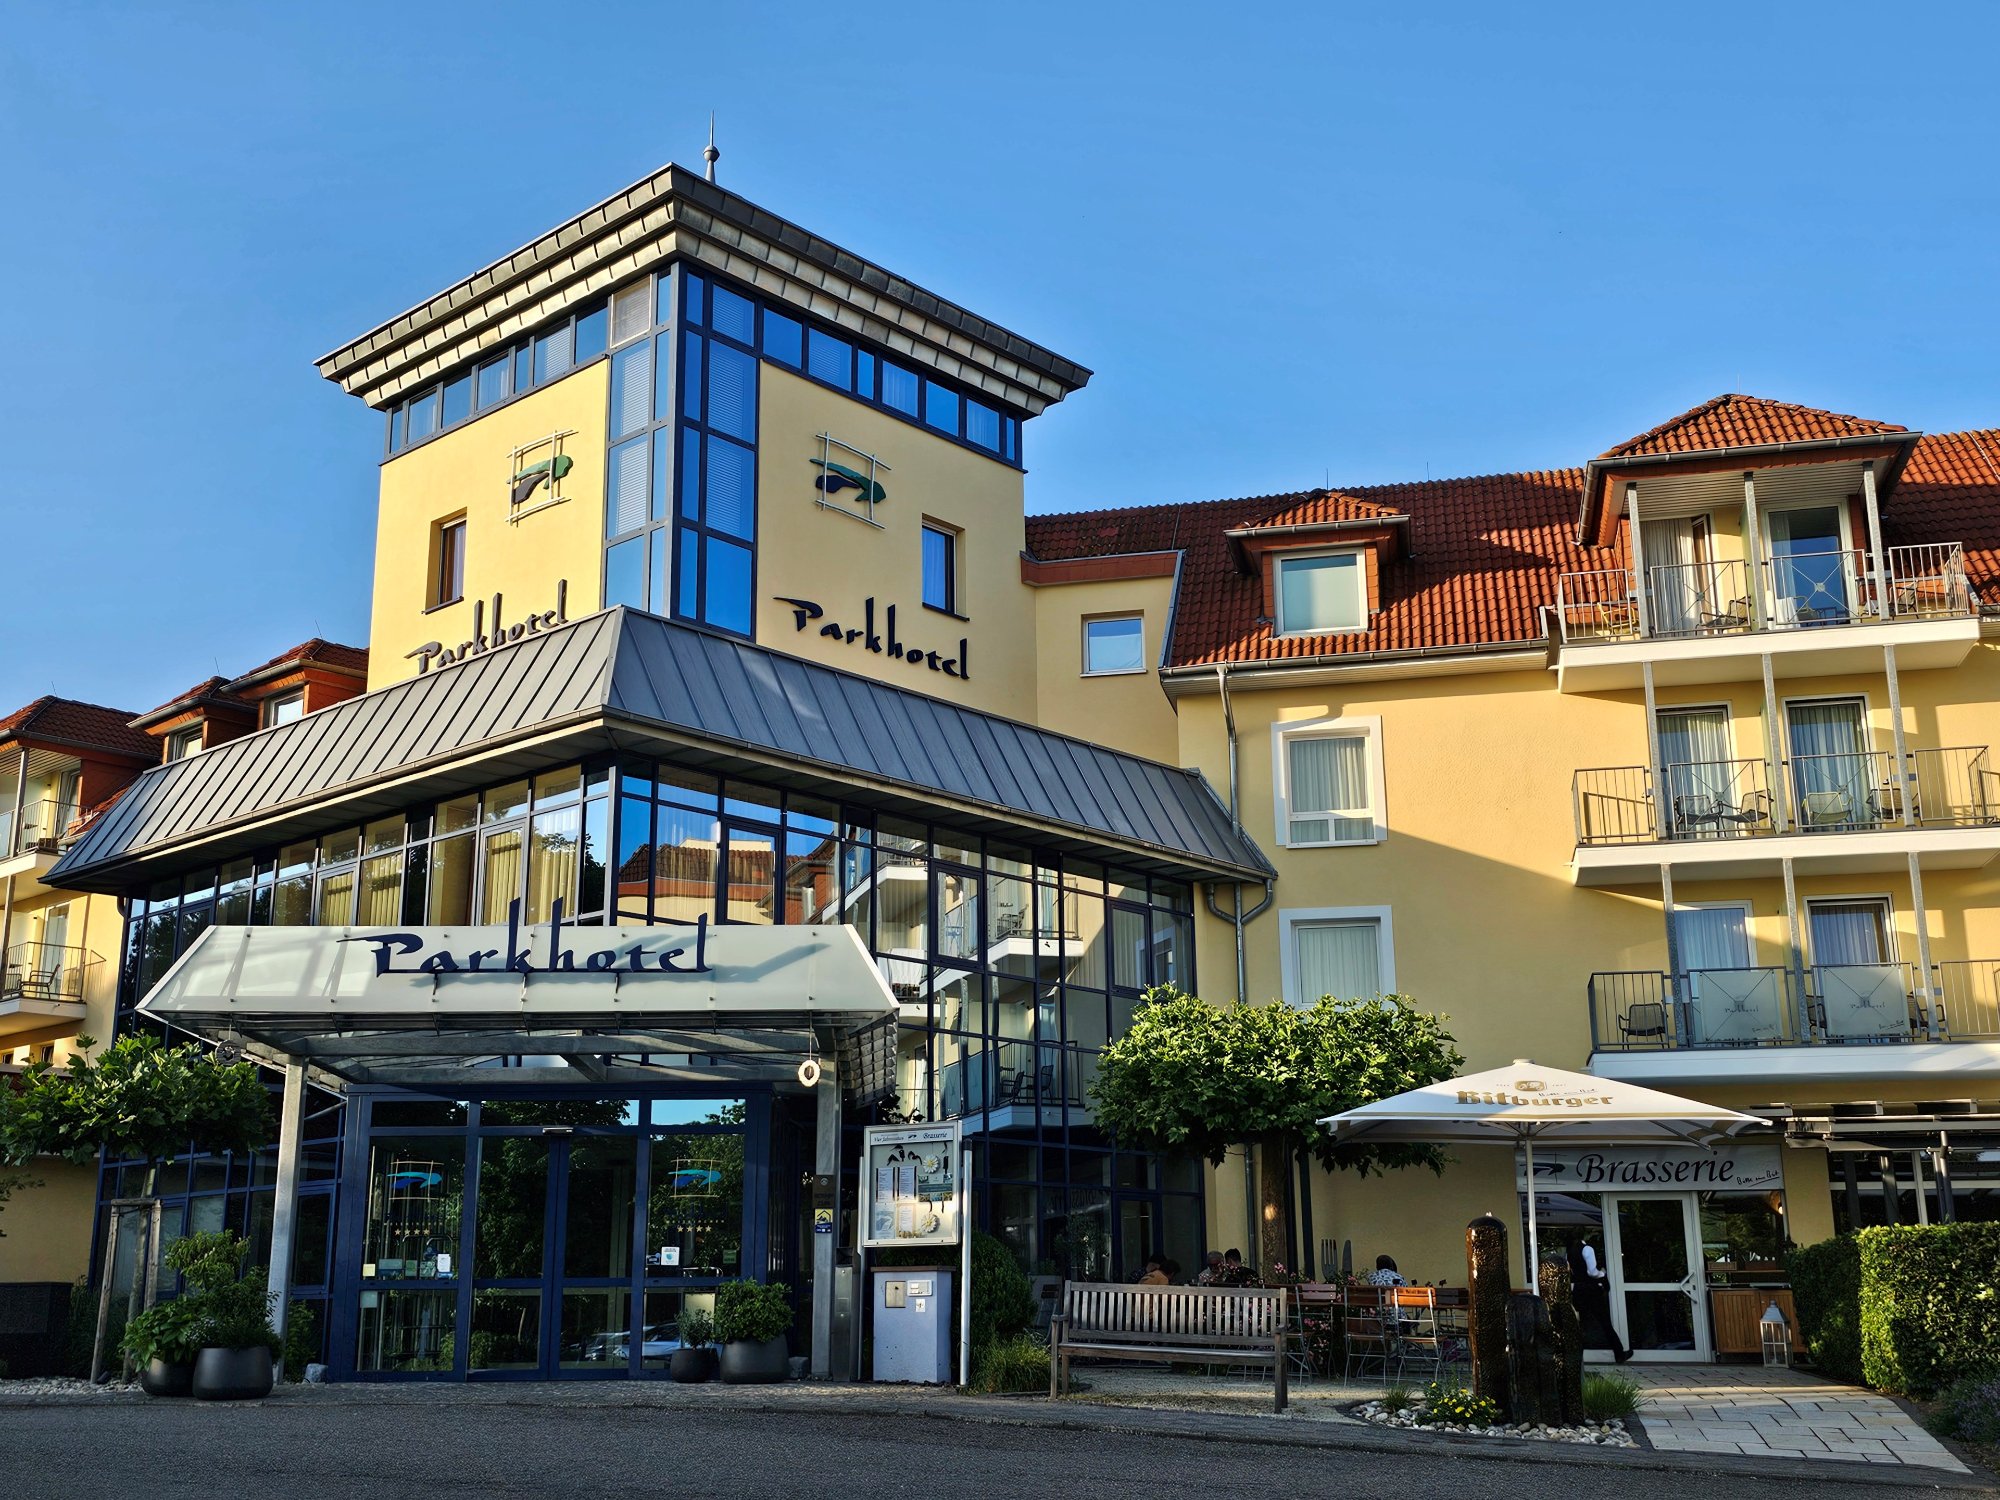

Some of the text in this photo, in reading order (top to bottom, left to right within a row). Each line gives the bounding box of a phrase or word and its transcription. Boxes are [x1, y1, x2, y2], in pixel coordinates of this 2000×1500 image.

[404, 579, 568, 675] Parkhotel
[773, 597, 970, 680] Parkhotel
[337, 897, 712, 977] Parkhotel
[1456, 1091, 1613, 1107] Bitburger
[1576, 1151, 1734, 1183] Brasserie
